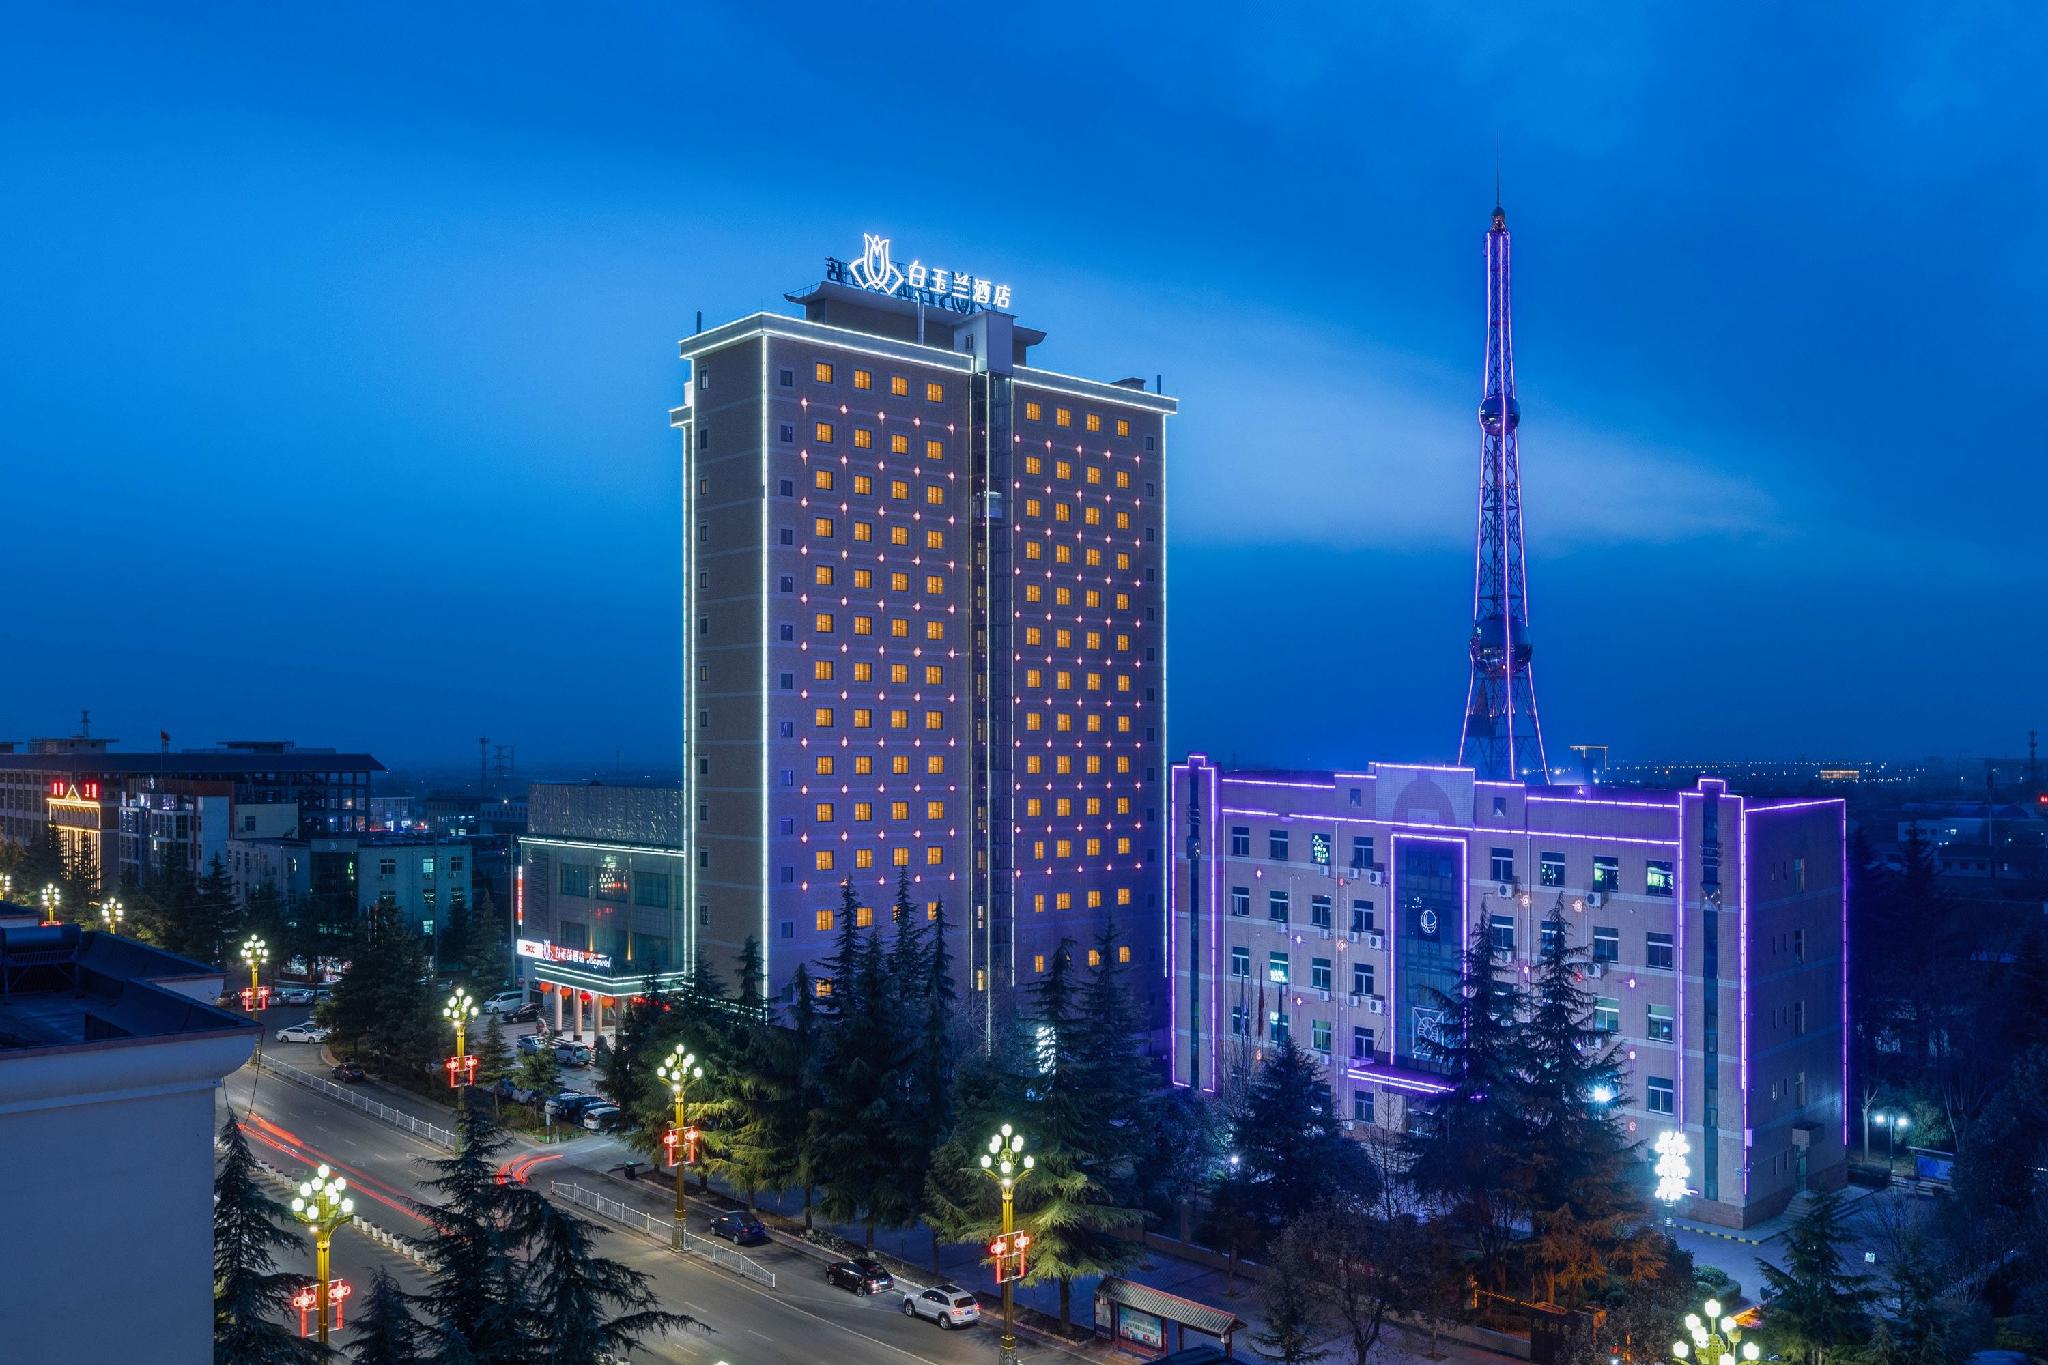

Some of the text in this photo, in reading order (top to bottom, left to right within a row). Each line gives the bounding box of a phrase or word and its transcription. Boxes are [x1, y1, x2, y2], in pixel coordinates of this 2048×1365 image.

[908, 260, 1011, 308] 白玉兰酒店
